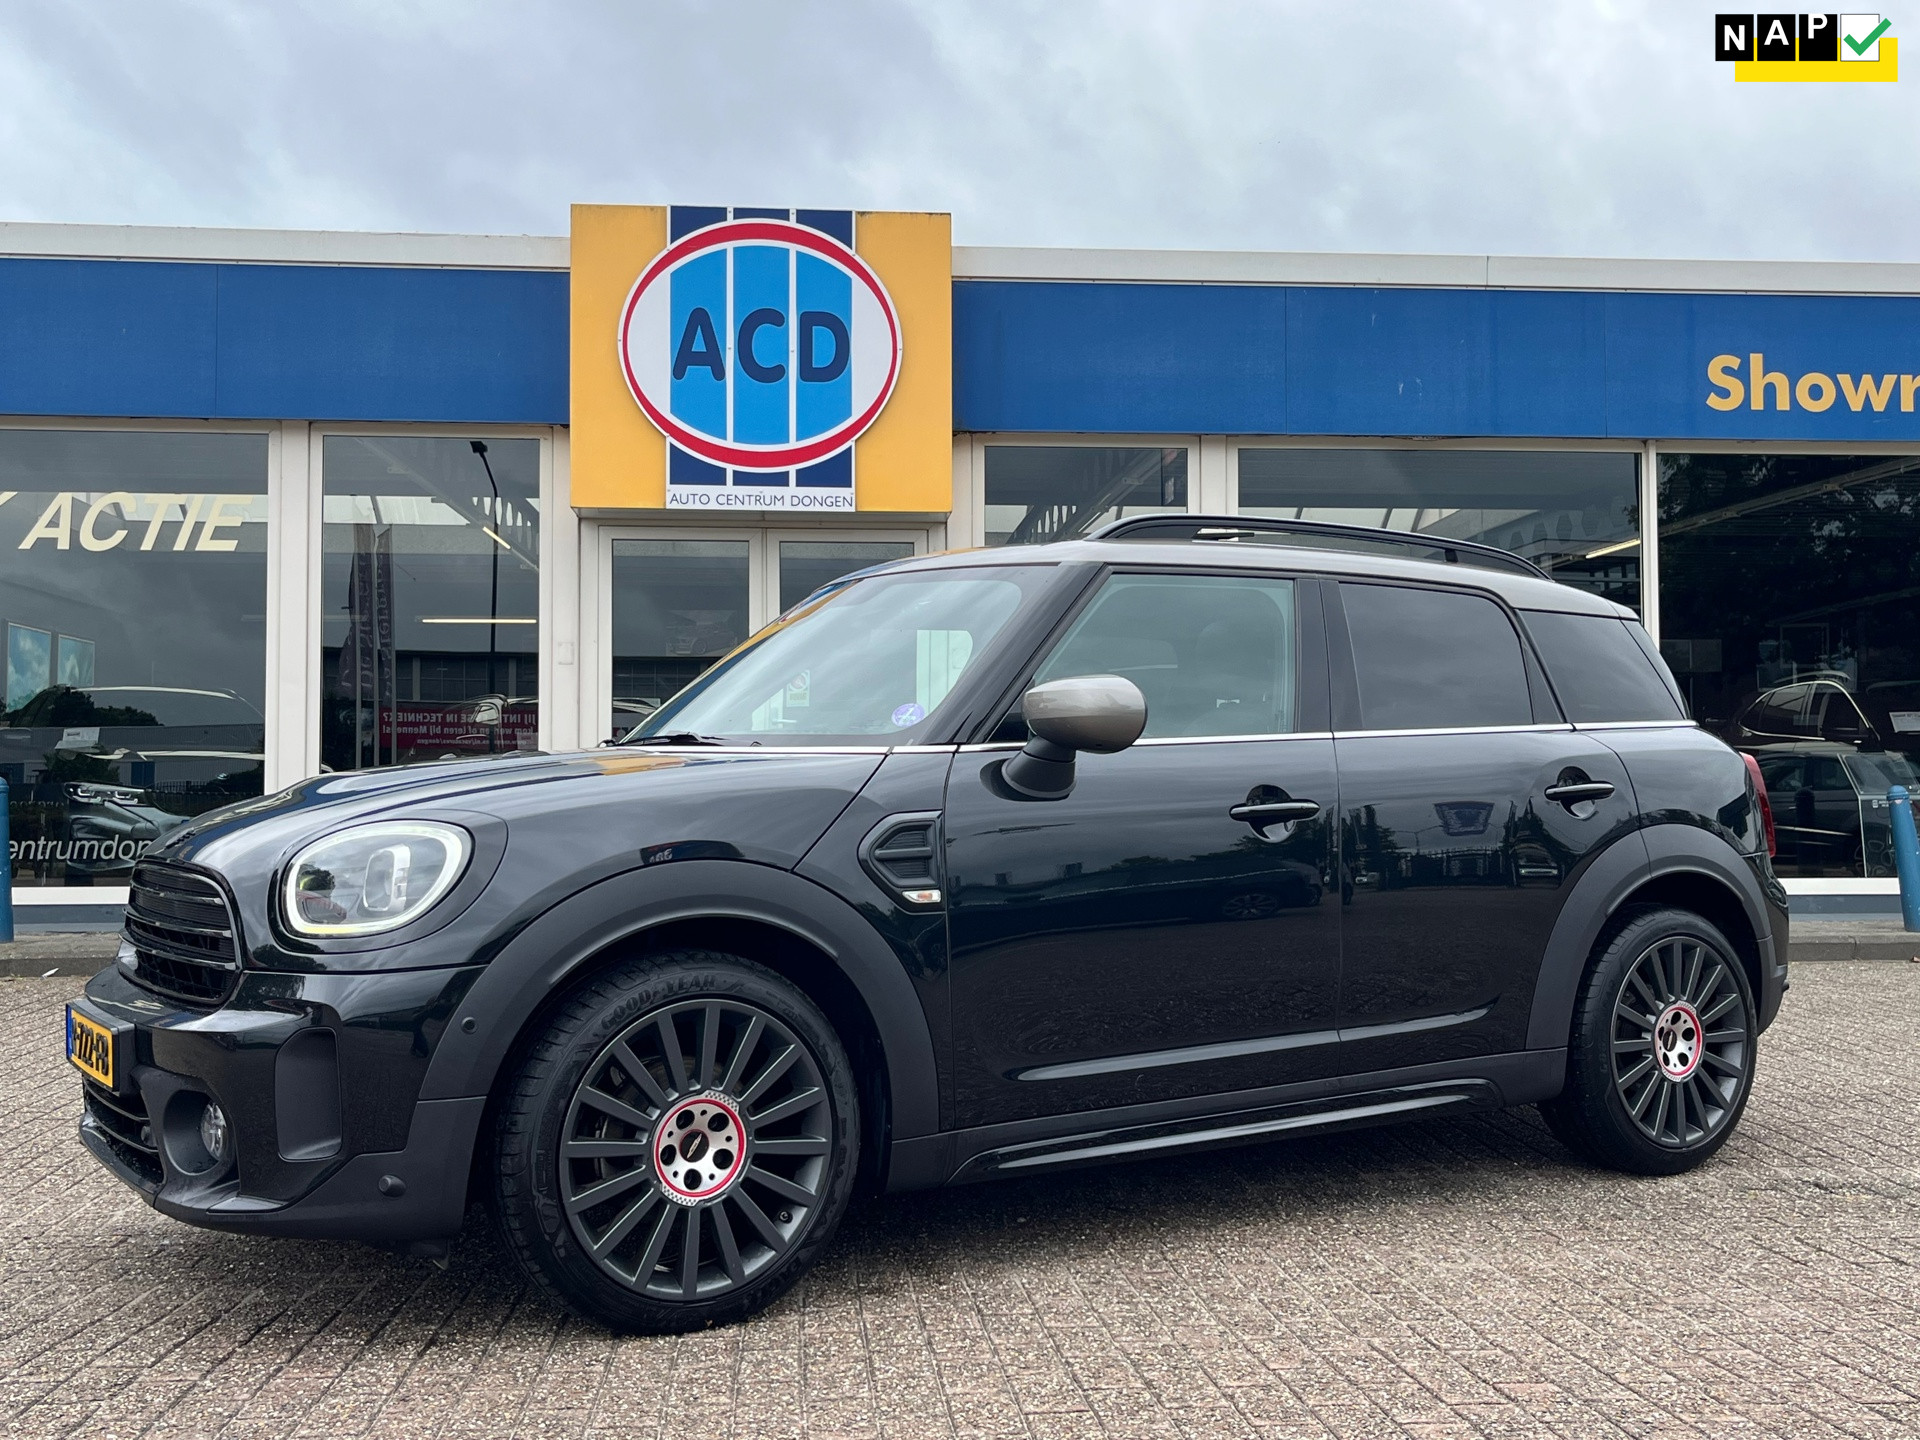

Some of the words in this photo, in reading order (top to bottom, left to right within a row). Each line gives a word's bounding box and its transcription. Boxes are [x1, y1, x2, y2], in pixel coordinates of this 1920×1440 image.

[672, 307, 851, 384] ACD
[1705, 353, 1920, 413] Showr
[18, 491, 253, 551] ACTIE
[669, 493, 711, 505] AUTO
[715, 494, 785, 506] CENTRUM
[790, 495, 853, 507] DONGEN
